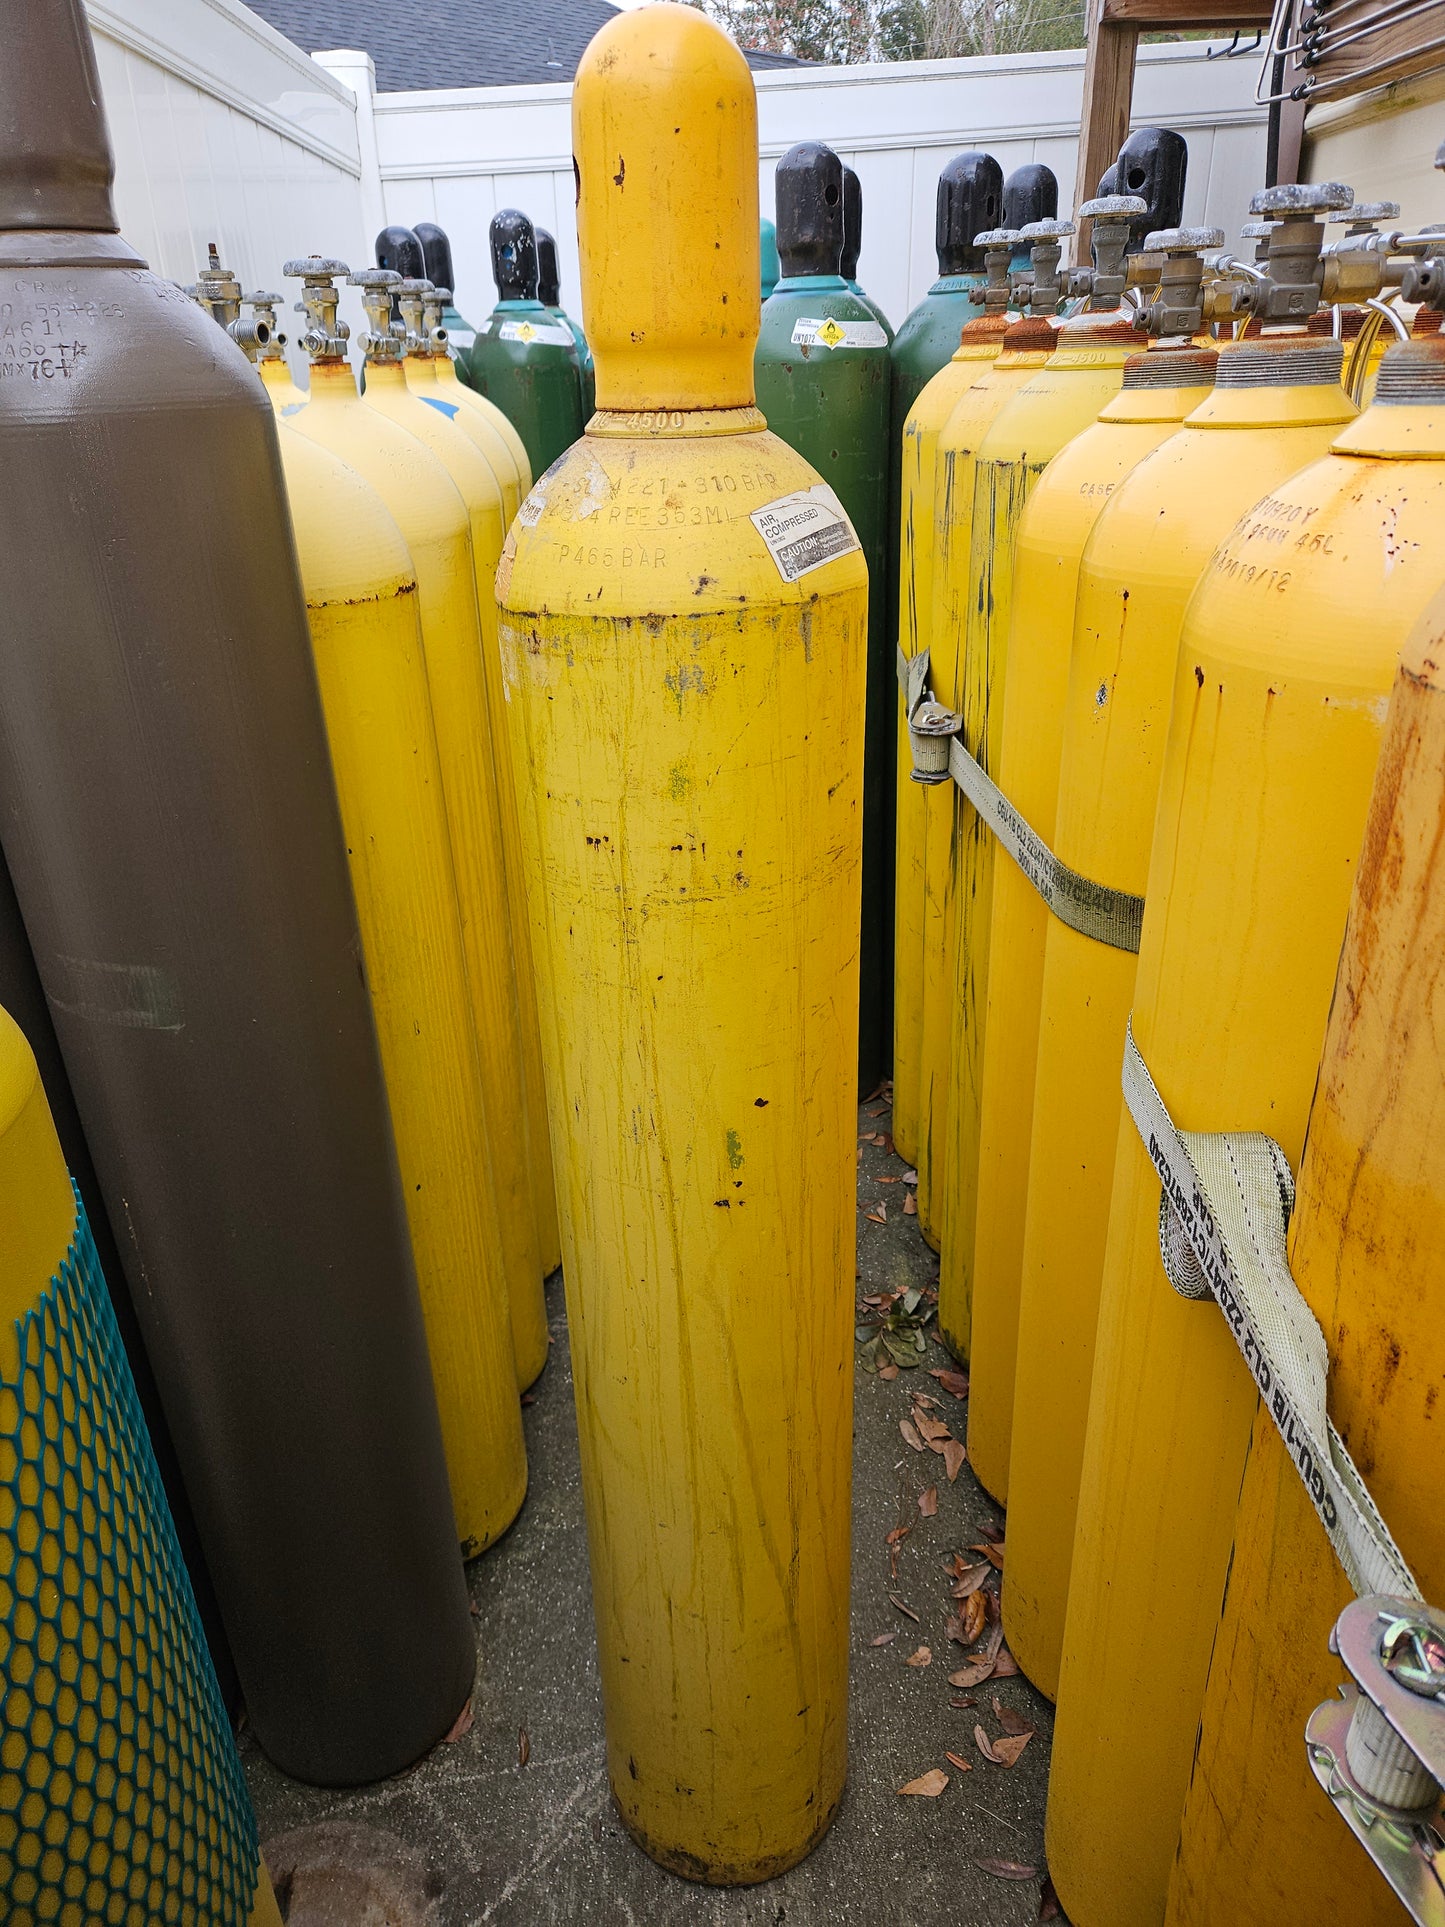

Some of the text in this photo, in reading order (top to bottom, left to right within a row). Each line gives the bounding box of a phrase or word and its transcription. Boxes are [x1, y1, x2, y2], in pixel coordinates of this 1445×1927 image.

[759, 513, 780, 529] AIR,
[765, 508, 819, 539] COMPRESSED
[780, 536, 819, 561] CAUTION:
[1243, 1331, 1271, 1393] CL2
[1272, 1393, 1338, 1529] CGU-1/B
